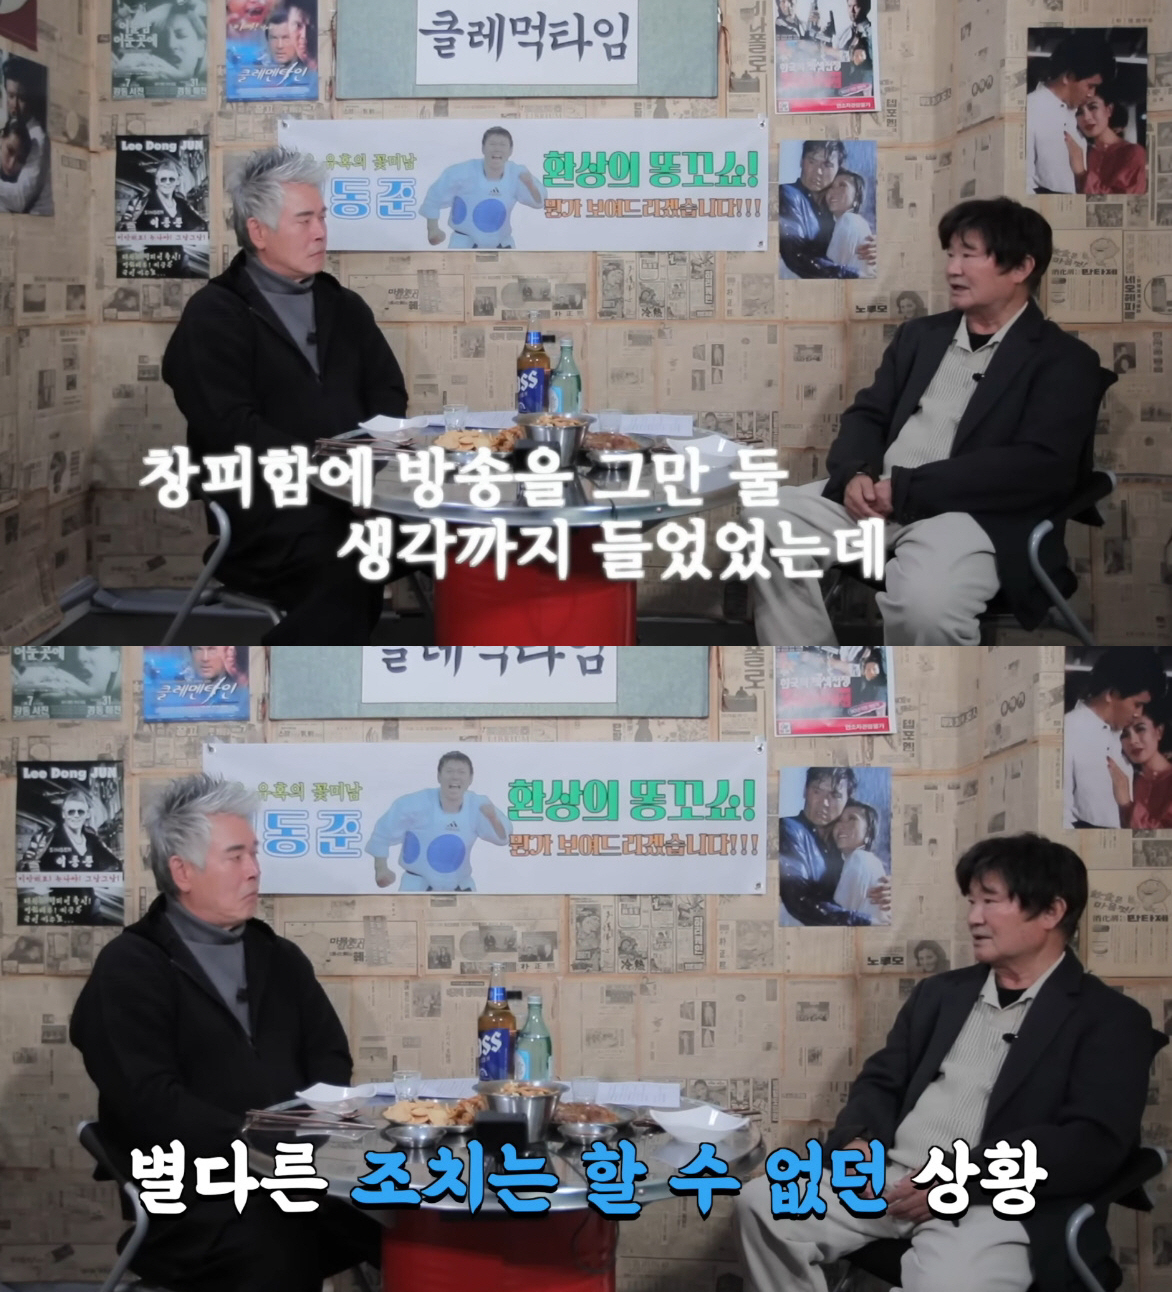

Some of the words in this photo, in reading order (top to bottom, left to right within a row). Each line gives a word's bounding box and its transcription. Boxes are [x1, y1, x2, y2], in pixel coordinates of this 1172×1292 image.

[418, 9, 630, 62] 클레먹타임
[121, 141, 143, 151] Lee
[145, 141, 178, 153] Dong
[180, 140, 204, 151] JUN
[372, 153, 418, 172] 꽃미남
[543, 151, 640, 189] 환상의
[649, 151, 759, 189] 똥꼬쇼!
[586, 198, 760, 219] 보여드리겠습니다!!!
[22, 768, 48, 779] Lee
[50, 767, 87, 781] Dong
[90, 767, 117, 779] JUN
[257, 781, 306, 802] 유혹의
[312, 781, 363, 803] 꽃미남
[508, 779, 619, 823] 환상의
[630, 779, 756, 823] 똥꼬쇼!
[557, 833, 758, 858] 보여드리겠습니다!!!
